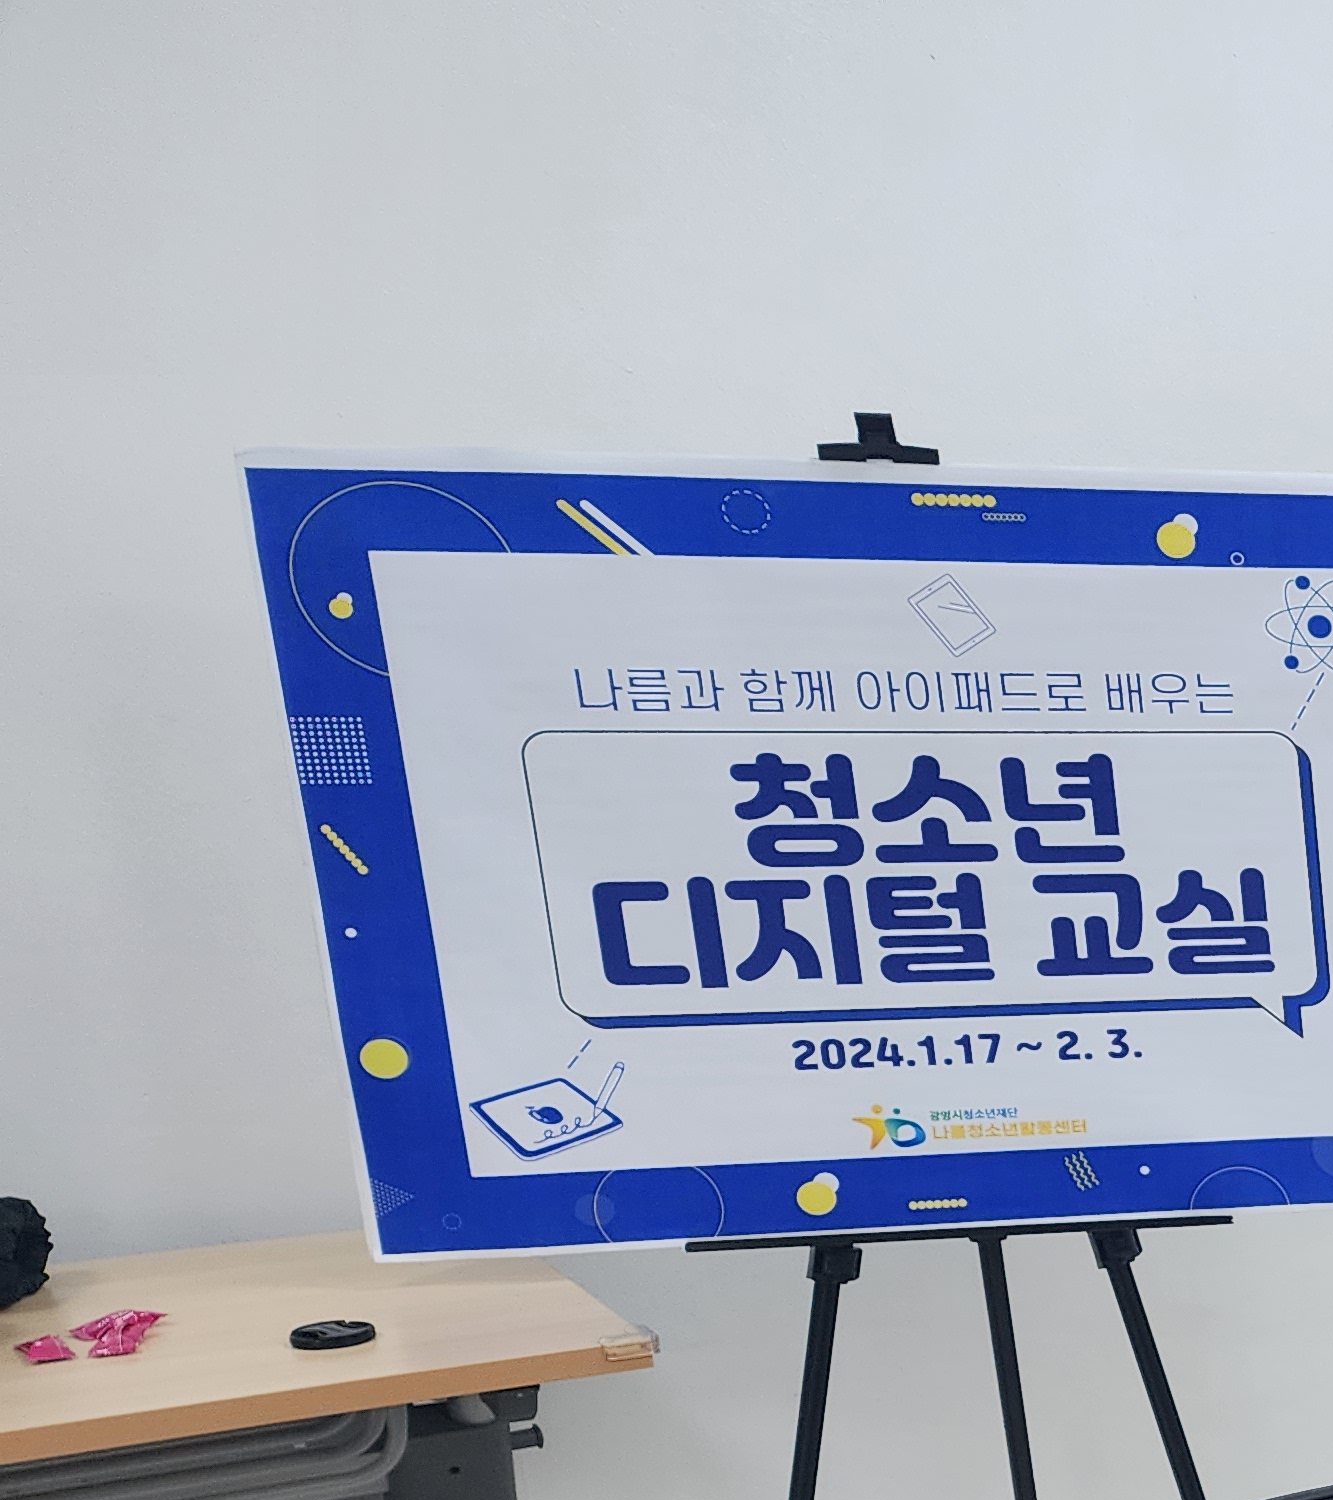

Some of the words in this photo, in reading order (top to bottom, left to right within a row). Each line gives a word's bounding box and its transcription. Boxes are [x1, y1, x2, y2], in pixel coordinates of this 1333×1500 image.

[574, 669, 724, 713] 나름과
[740, 669, 835, 714] 함께
[856, 669, 1086, 714] 아이패드로
[1106, 672, 1235, 715] 배우는
[729, 752, 1125, 867] 청소년
[591, 870, 996, 990] 디지털
[1032, 866, 1275, 977] 교실
[791, 1033, 1001, 1070] 2024.1.17
